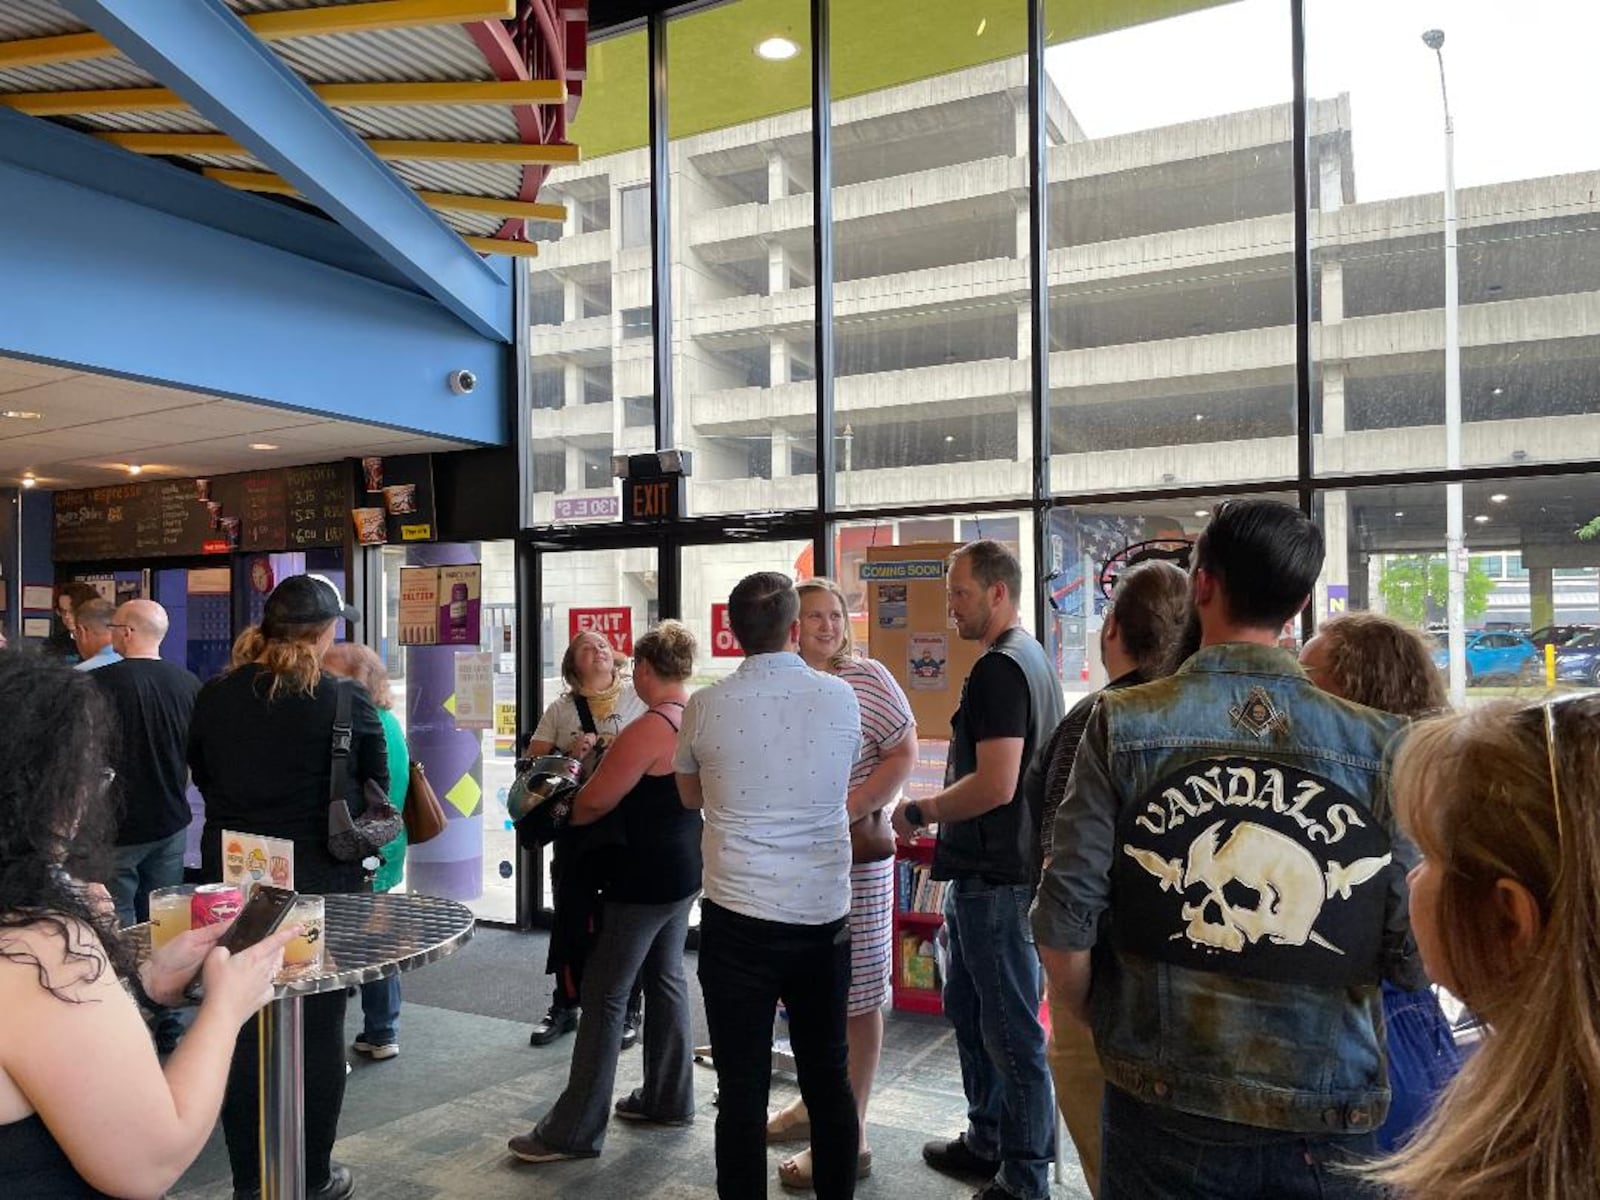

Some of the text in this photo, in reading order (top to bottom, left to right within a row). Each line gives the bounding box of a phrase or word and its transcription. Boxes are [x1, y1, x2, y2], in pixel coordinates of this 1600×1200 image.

[633, 482, 670, 516] EXIT
[862, 564, 940, 577] COMING SOON
[402, 592, 434, 601] SELTZER
[1330, 598, 1345, 612] N
[577, 613, 623, 632] EXIT
[1136, 766, 1366, 845] VANDALS
